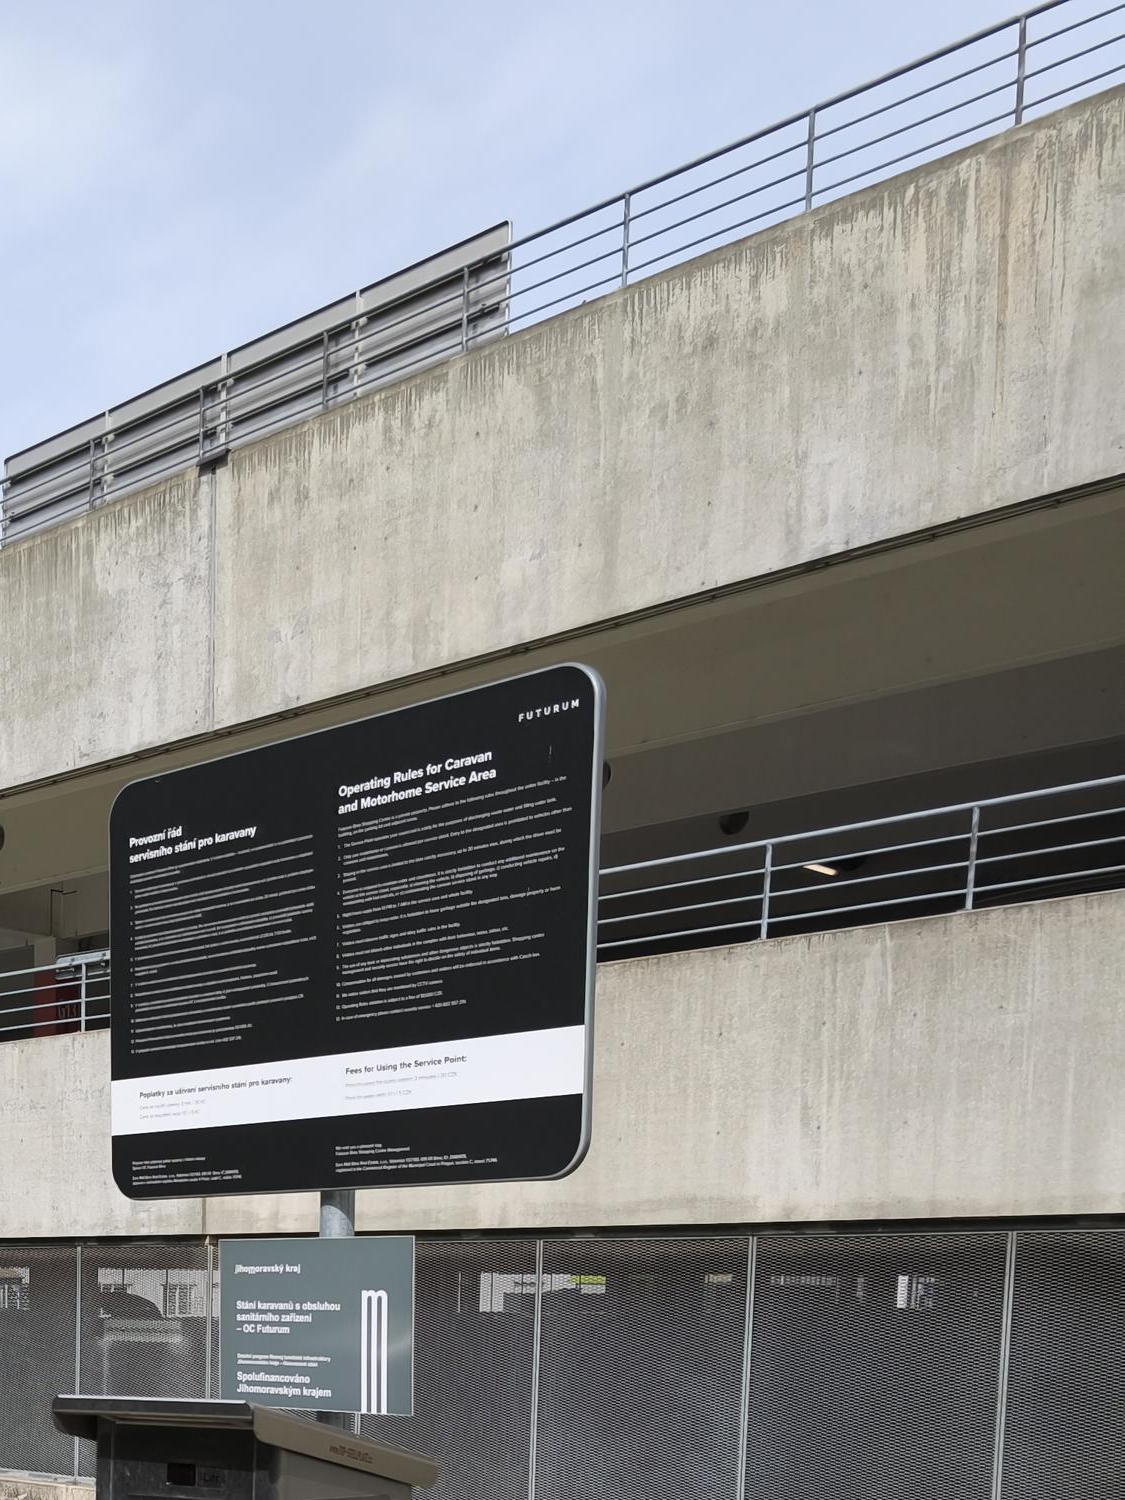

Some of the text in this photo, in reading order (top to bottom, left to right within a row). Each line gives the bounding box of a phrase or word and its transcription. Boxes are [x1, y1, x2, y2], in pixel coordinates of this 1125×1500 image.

[518, 698, 579, 723] FUTURUM
[338, 751, 493, 798] Operating Rules for Caravan
[338, 800, 358, 815] and
[360, 785, 422, 810] Motorhome
[424, 775, 466, 794] Service
[468, 769, 497, 784] Area
[129, 825, 182, 848] Provozní řád
[129, 826, 257, 864] servisního stání pro karavany
[345, 1055, 467, 1075] Fees for Using the Service Point:
[139, 1090, 165, 1099] Poplatky
[248, 1079, 260, 1088] pro
[285, 1264, 301, 1274] kraj
[236, 1300, 256, 1310] Stání
[257, 1300, 294, 1310] karavanů
[302, 1301, 341, 1311] obsluhou
[236, 1312, 312, 1322] sanitárního zařízení
[243, 1324, 255, 1333] OC
[257, 1324, 290, 1334] Futurum
[237, 1371, 310, 1384] Spolufinancováno
[237, 1383, 332, 1398] Jihomoravským krajem
